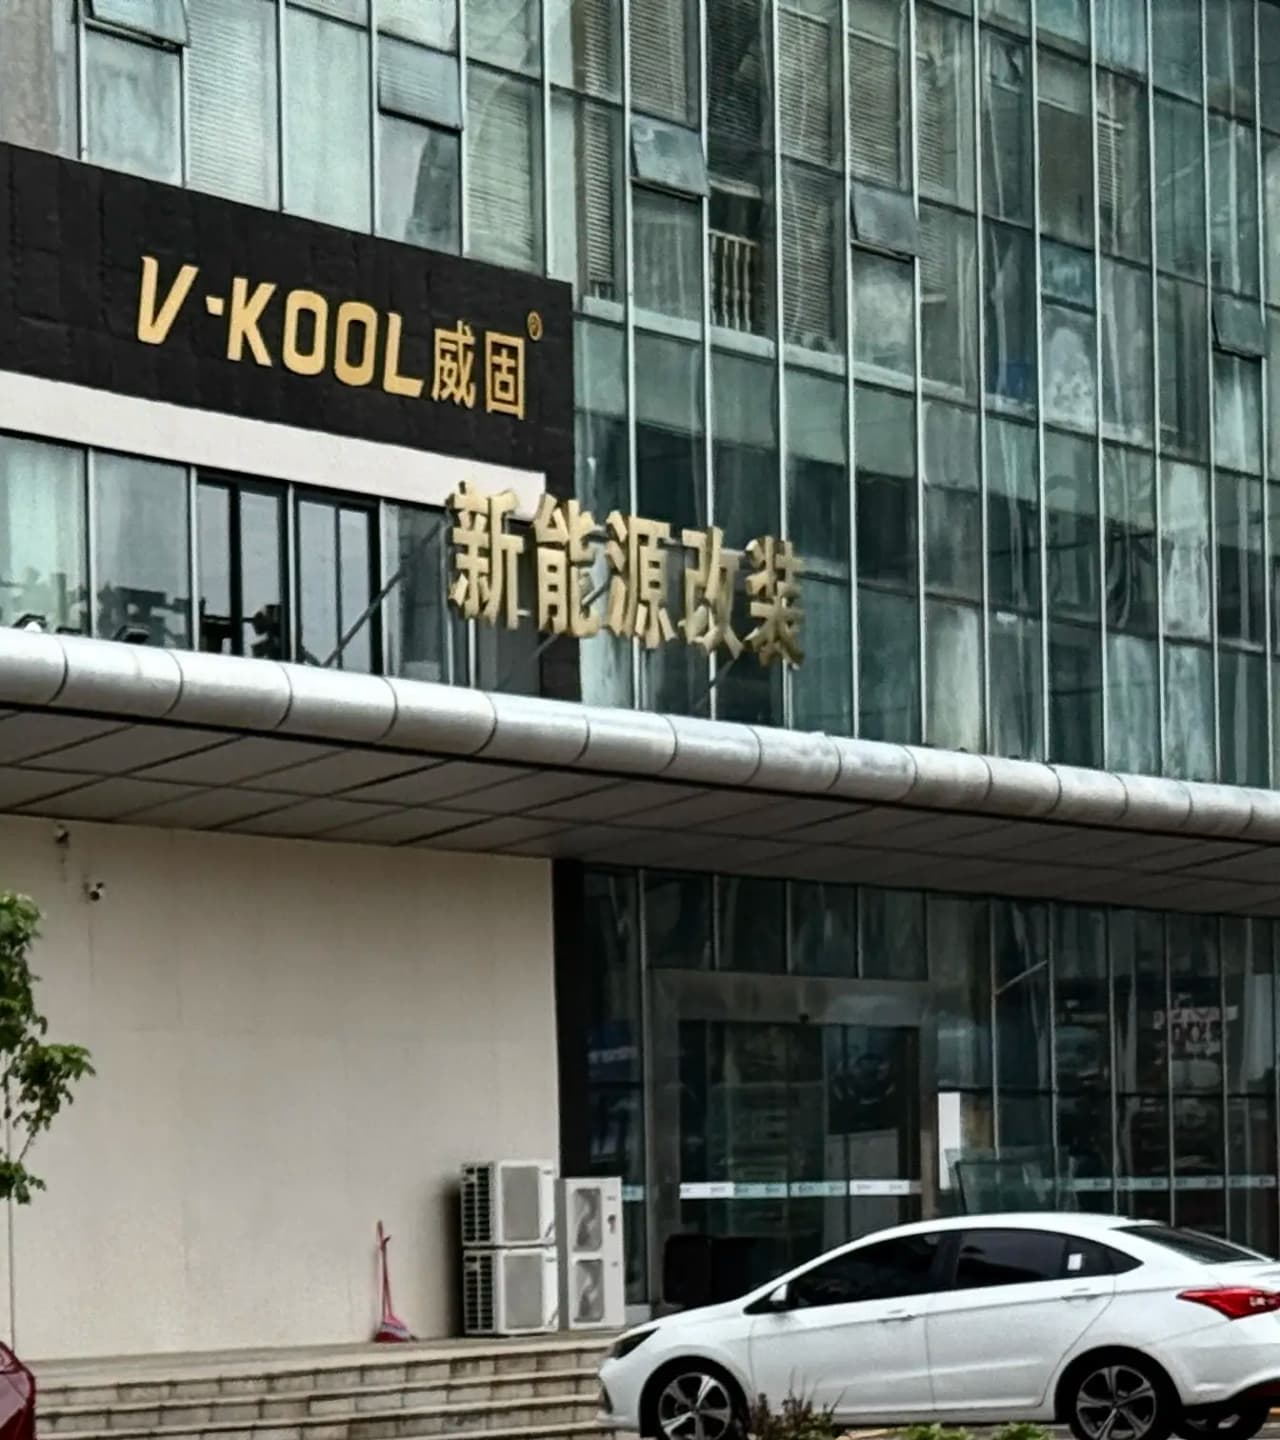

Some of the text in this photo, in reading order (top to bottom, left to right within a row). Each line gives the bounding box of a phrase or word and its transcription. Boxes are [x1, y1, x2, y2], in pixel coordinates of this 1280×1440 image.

[431, 320, 526, 420] 威固
[445, 481, 806, 668] 新能源改装
